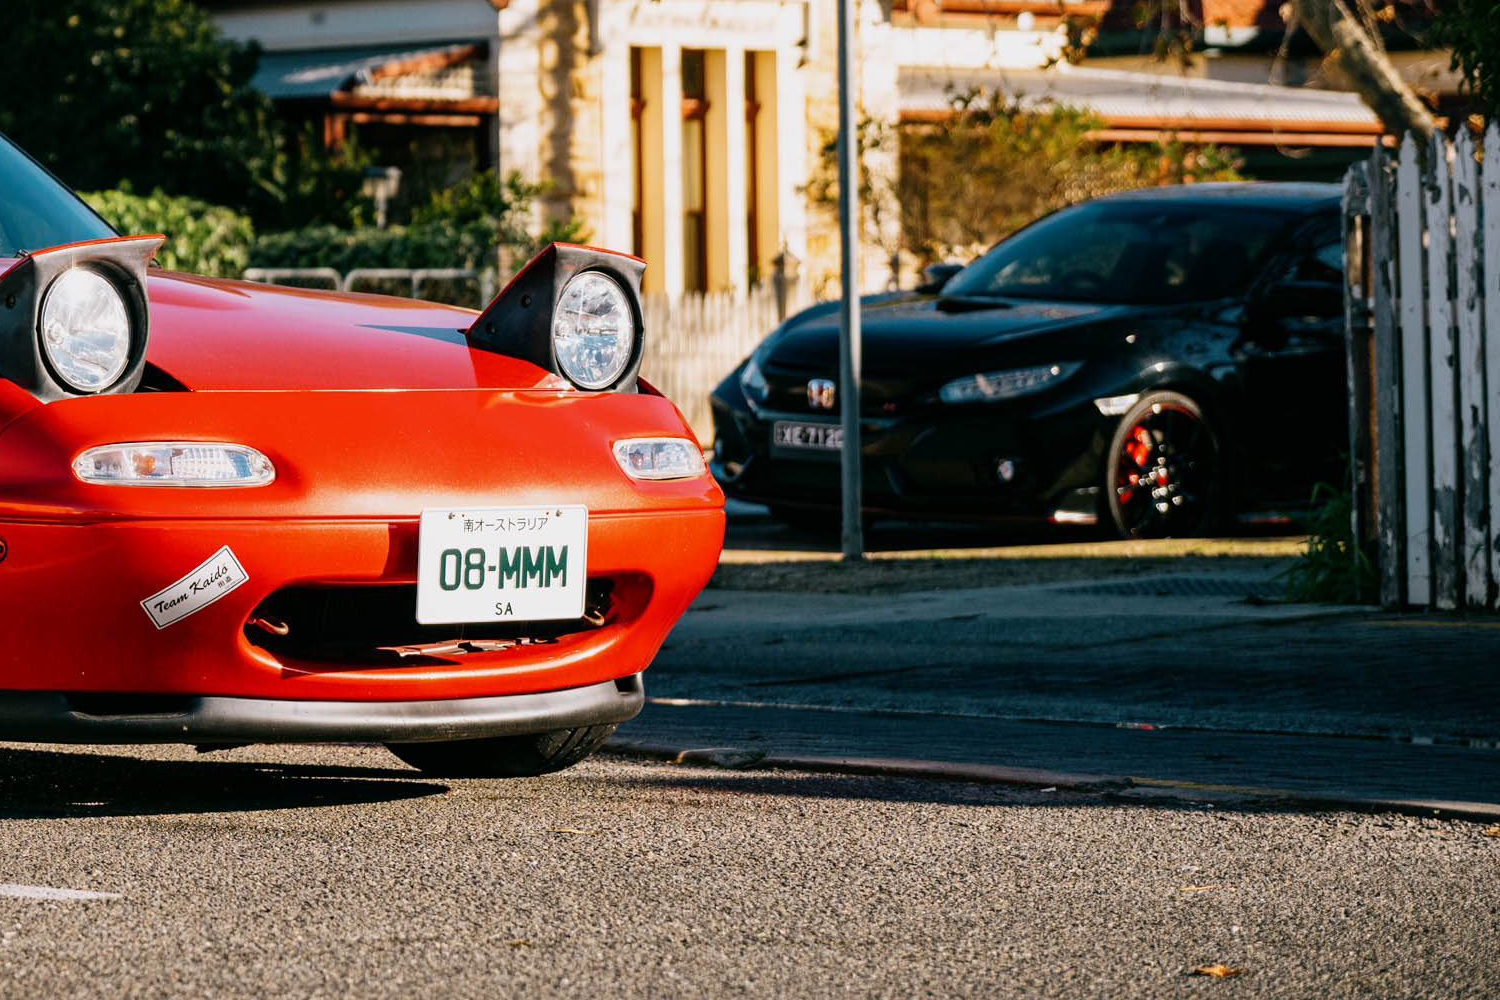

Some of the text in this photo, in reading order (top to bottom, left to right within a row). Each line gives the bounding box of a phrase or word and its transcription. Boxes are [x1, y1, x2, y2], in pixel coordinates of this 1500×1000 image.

[463, 517, 548, 533] 南オーストラリア
[439, 545, 568, 591] 08-MMM
[154, 592, 189, 613] Team
[189, 565, 228, 595] Kaido
[495, 602, 514, 616] SA
